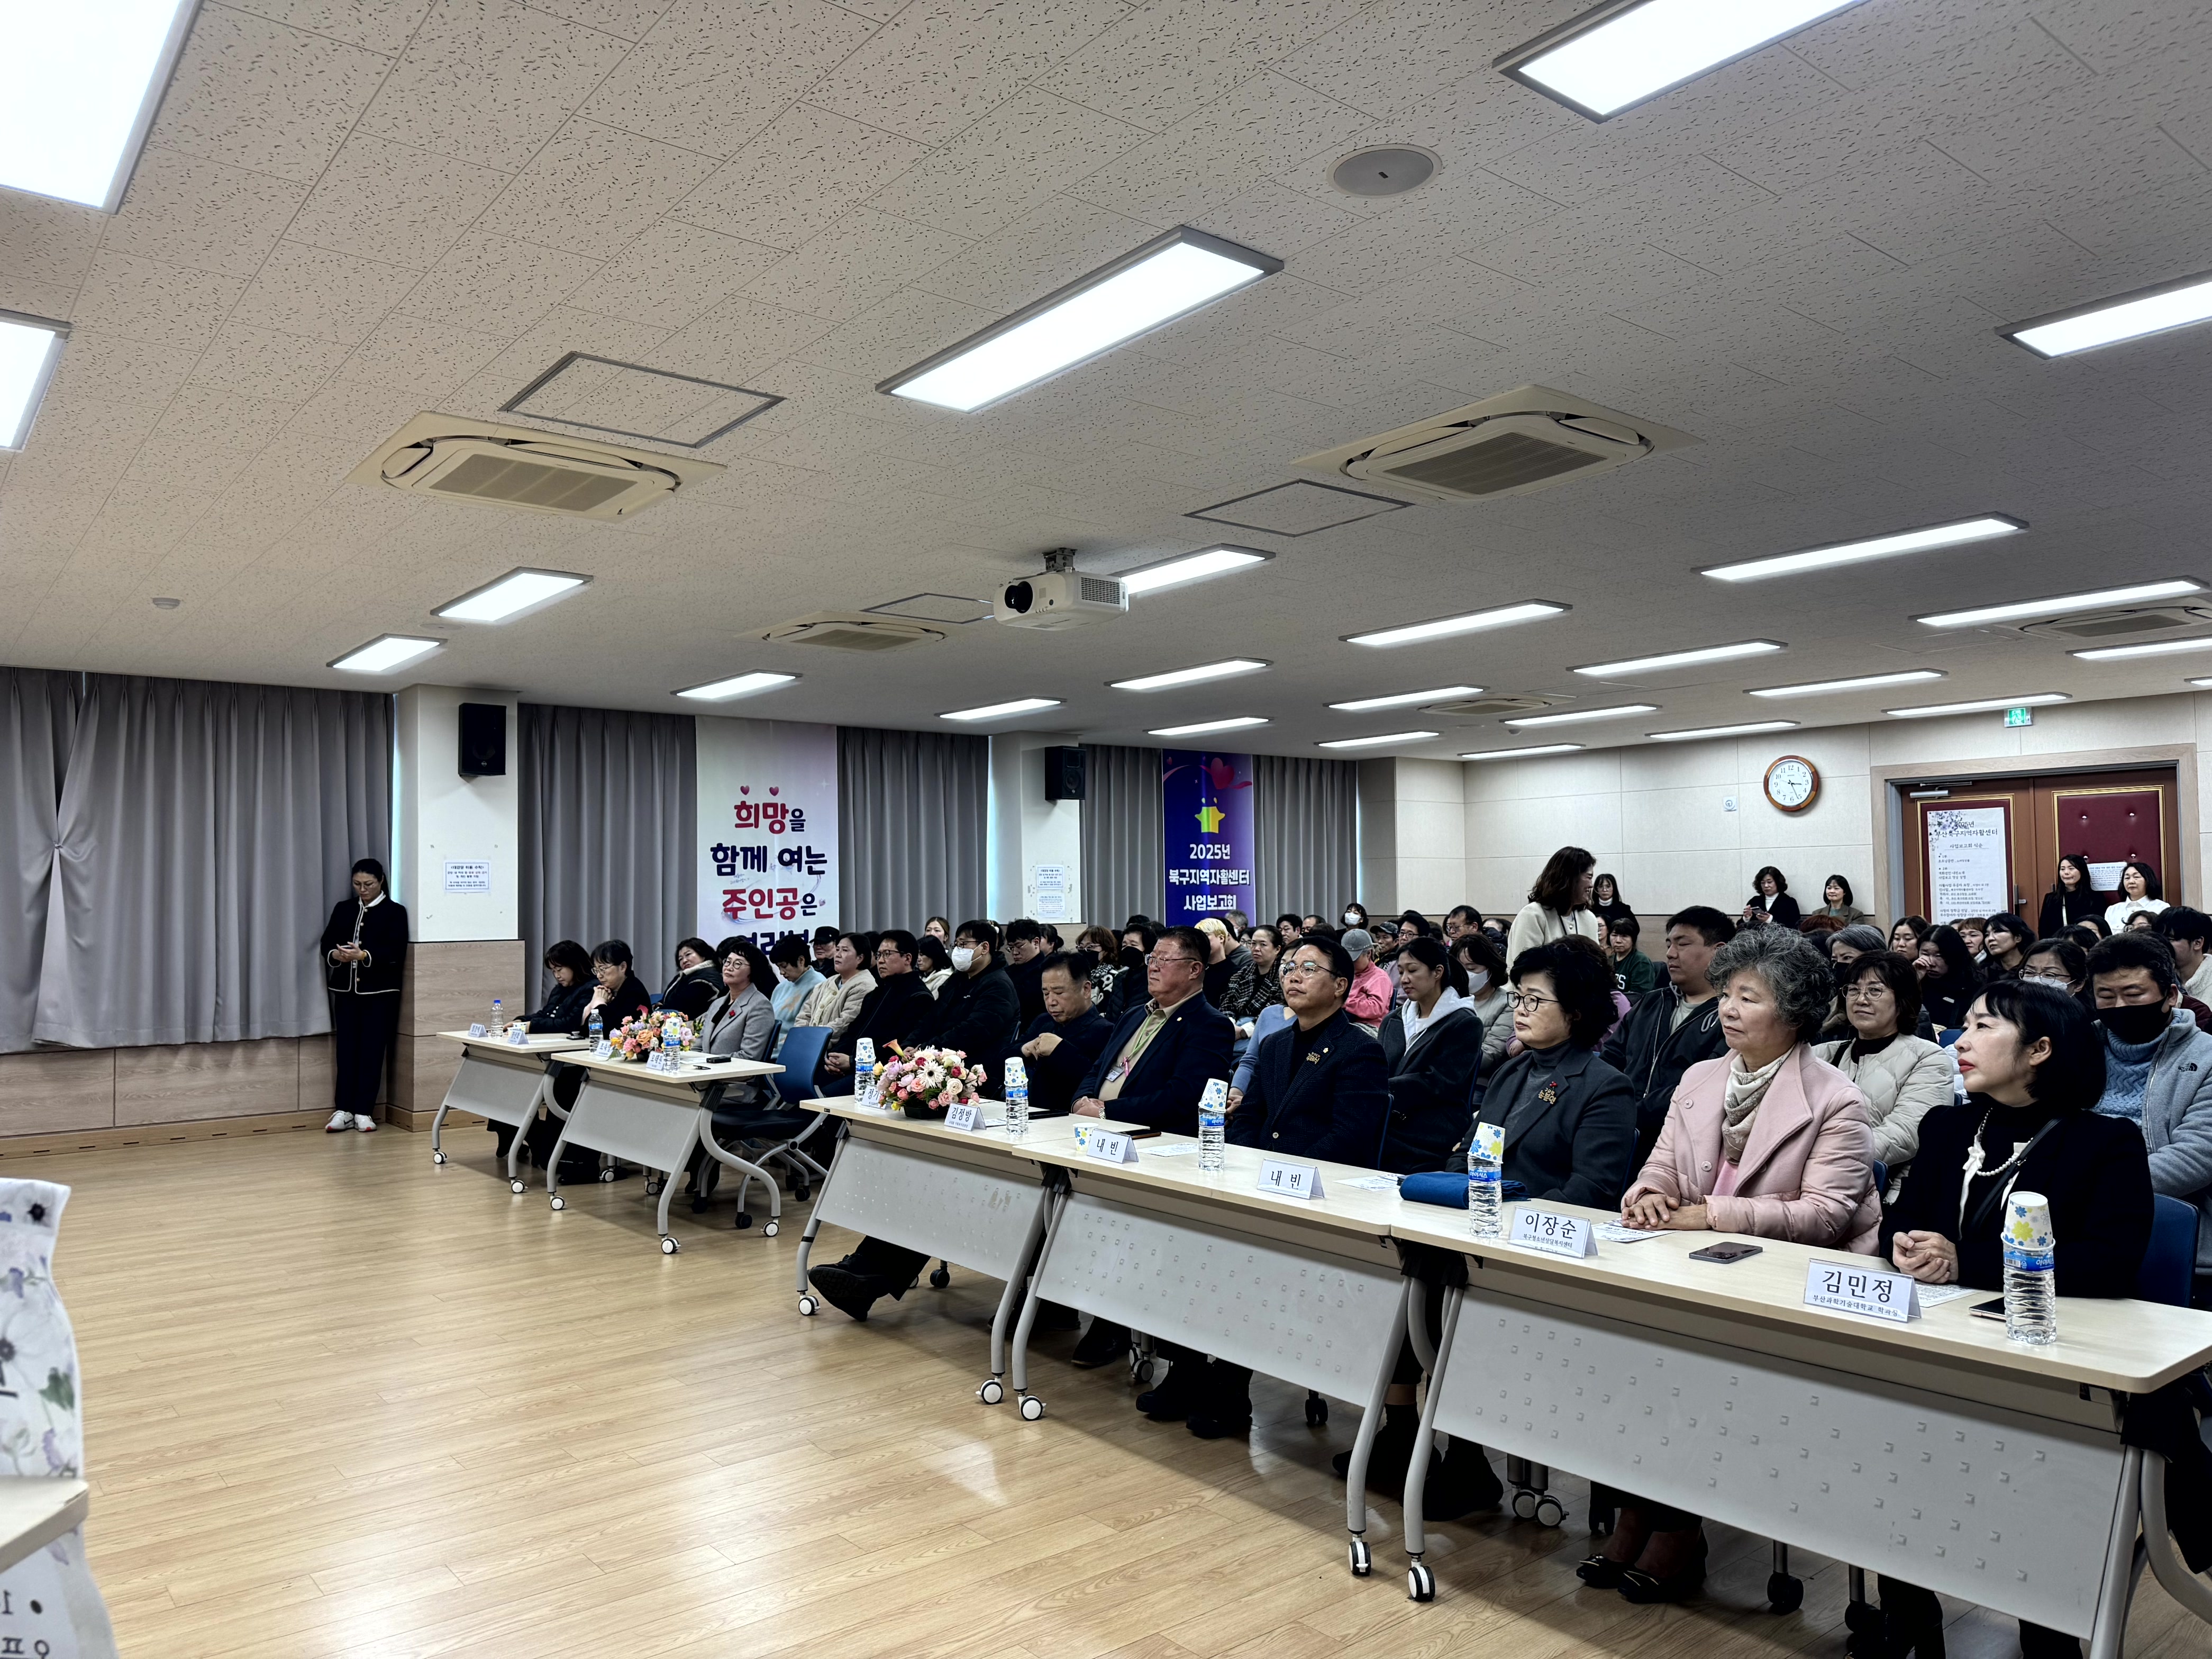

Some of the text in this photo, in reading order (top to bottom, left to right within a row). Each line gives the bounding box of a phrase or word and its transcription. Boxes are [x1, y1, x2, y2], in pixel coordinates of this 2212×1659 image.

[734, 800, 806, 834] 희망을
[710, 843, 827, 876] 함께 여는
[1189, 844, 1230, 860] 2025년
[1169, 869, 1250, 885] 북구지역자활센터
[723, 888, 817, 920] 주인공은
[1184, 895, 1236, 911] 사업보고회
[868, 1088, 879, 1100] 정기
[952, 1107, 972, 1122] 김정방
[1526, 1213, 1577, 1239] 이장순
[1822, 1271, 1892, 1303] 김민정
[1813, 1295, 1898, 1317] 부산과학기술대학교 학과장
